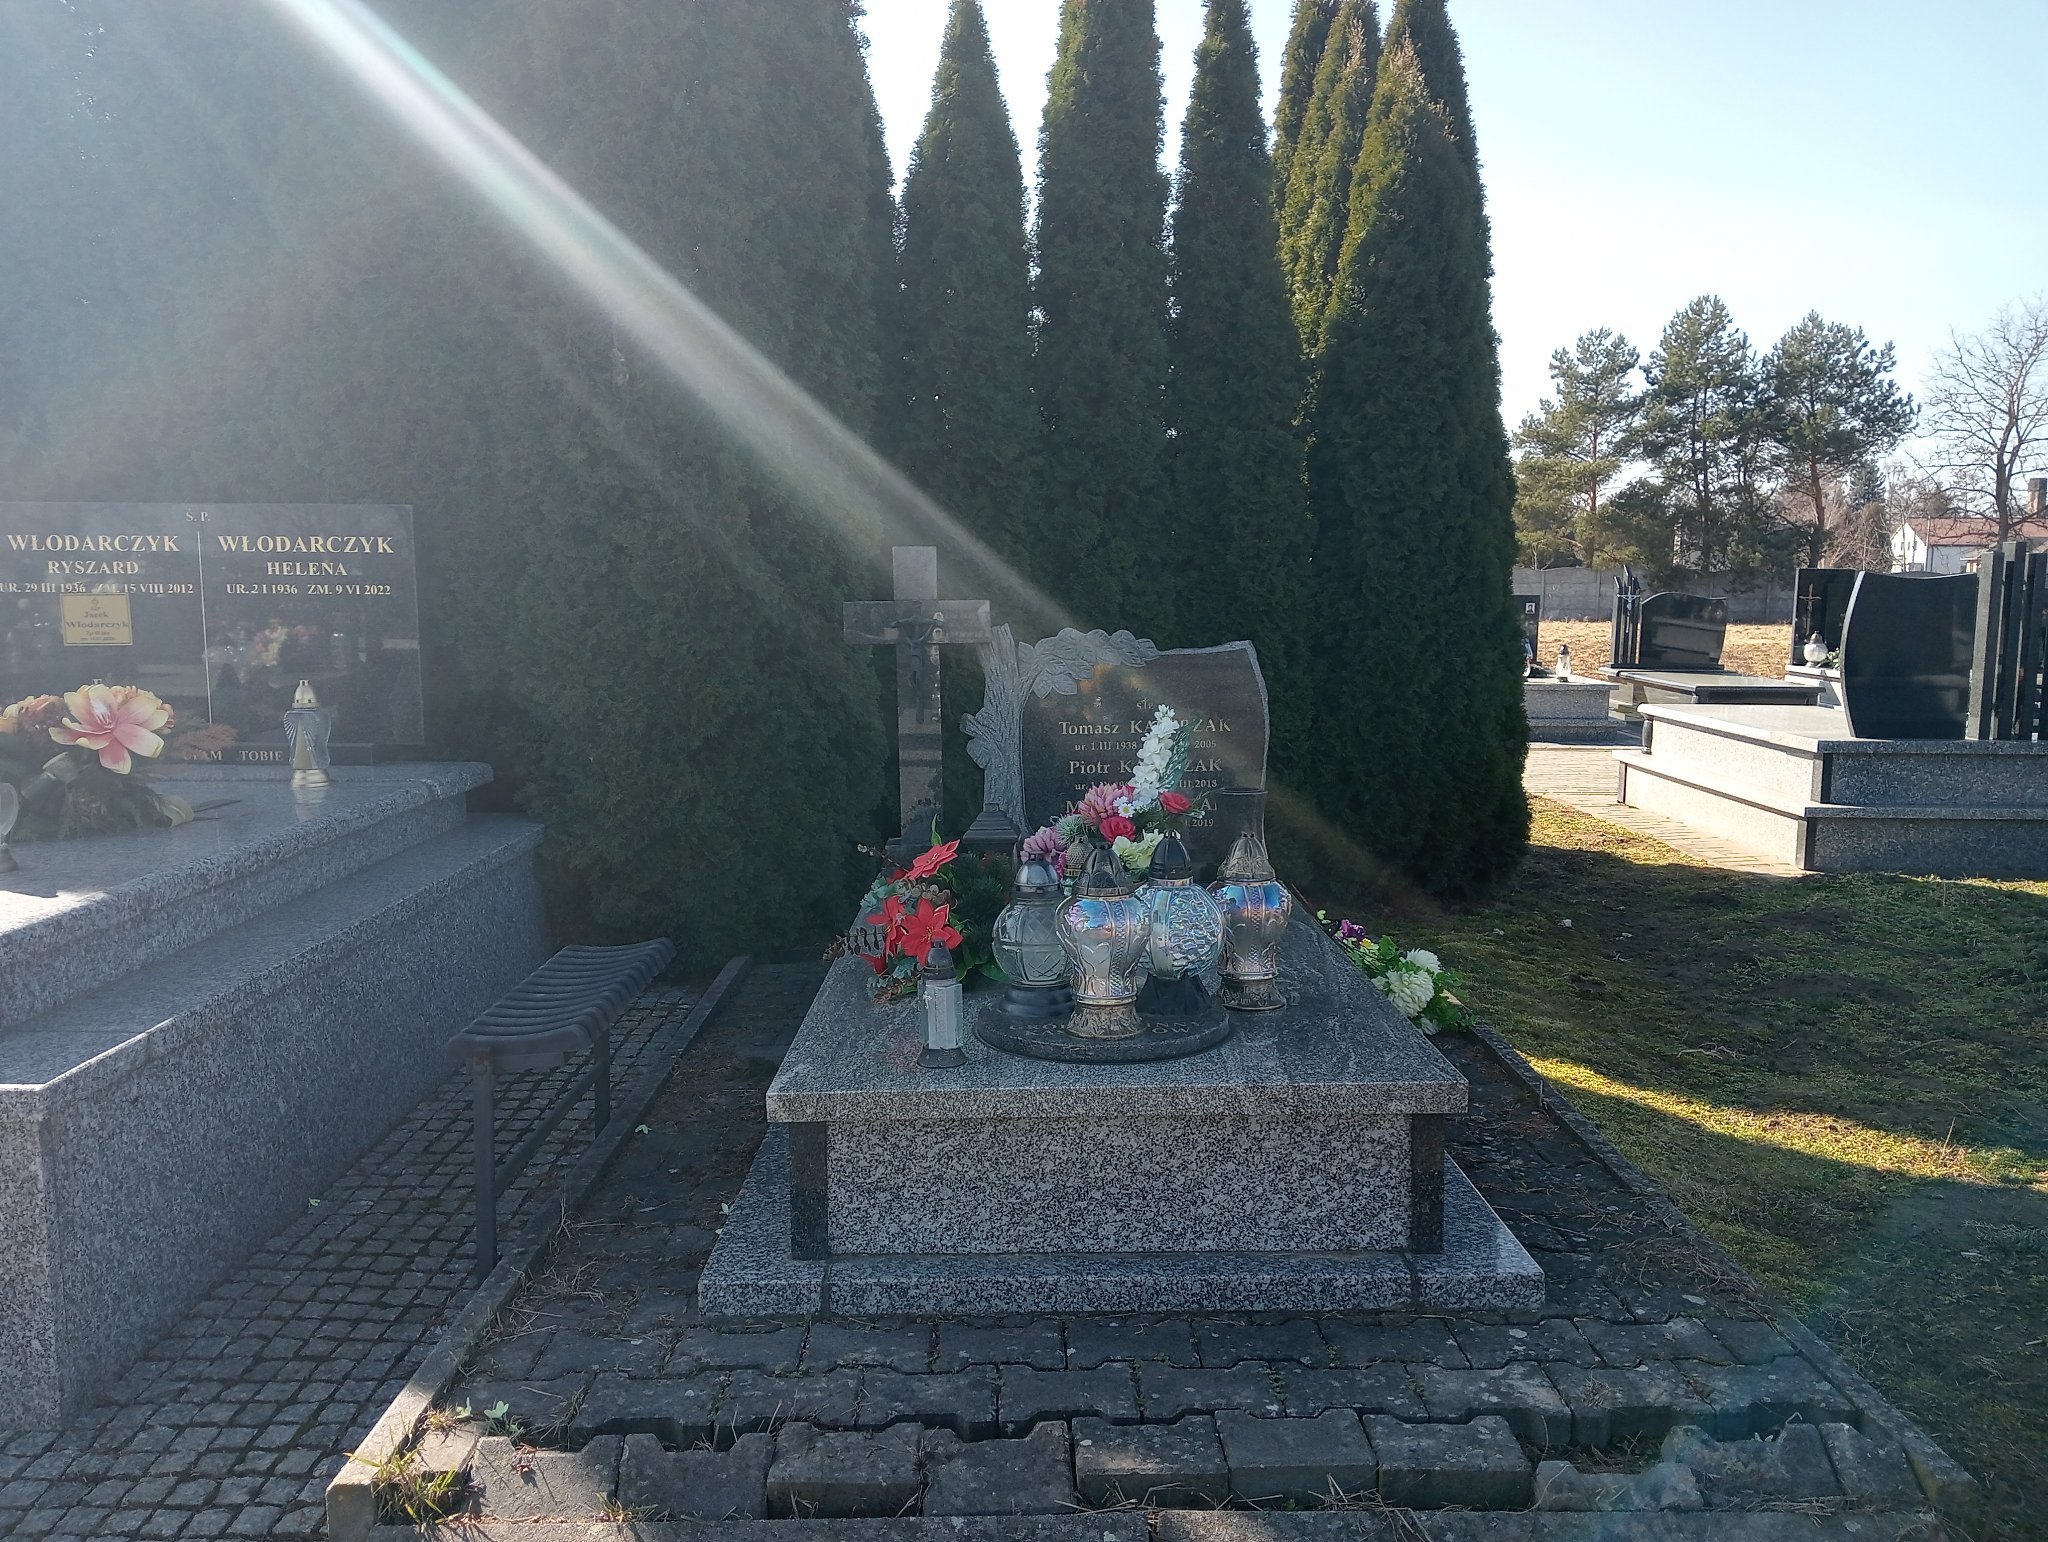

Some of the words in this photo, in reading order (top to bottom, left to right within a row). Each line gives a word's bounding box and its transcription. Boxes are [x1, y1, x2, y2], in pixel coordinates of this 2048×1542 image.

[7, 534, 180, 552] WŁODARCZYK
[218, 535, 394, 554] WŁODARCZYK
[48, 560, 139, 575] RYSZARD
[267, 561, 348, 576] HELENA
[25, 583, 38, 593] 29
[41, 583, 56, 593] III
[60, 582, 86, 593] 1936
[124, 583, 137, 594] 15
[141, 583, 164, 594] VIII
[168, 583, 193, 594] 2012
[272, 584, 298, 595] 1936
[307, 584, 332, 595] ZM.
[335, 584, 342, 595] 9
[346, 584, 360, 595] VI
[364, 585, 391, 595] 2022
[1058, 721, 1120, 735] Tomasz
[239, 750, 283, 761] TOBIE
[1069, 760, 1111, 774] Piotr
